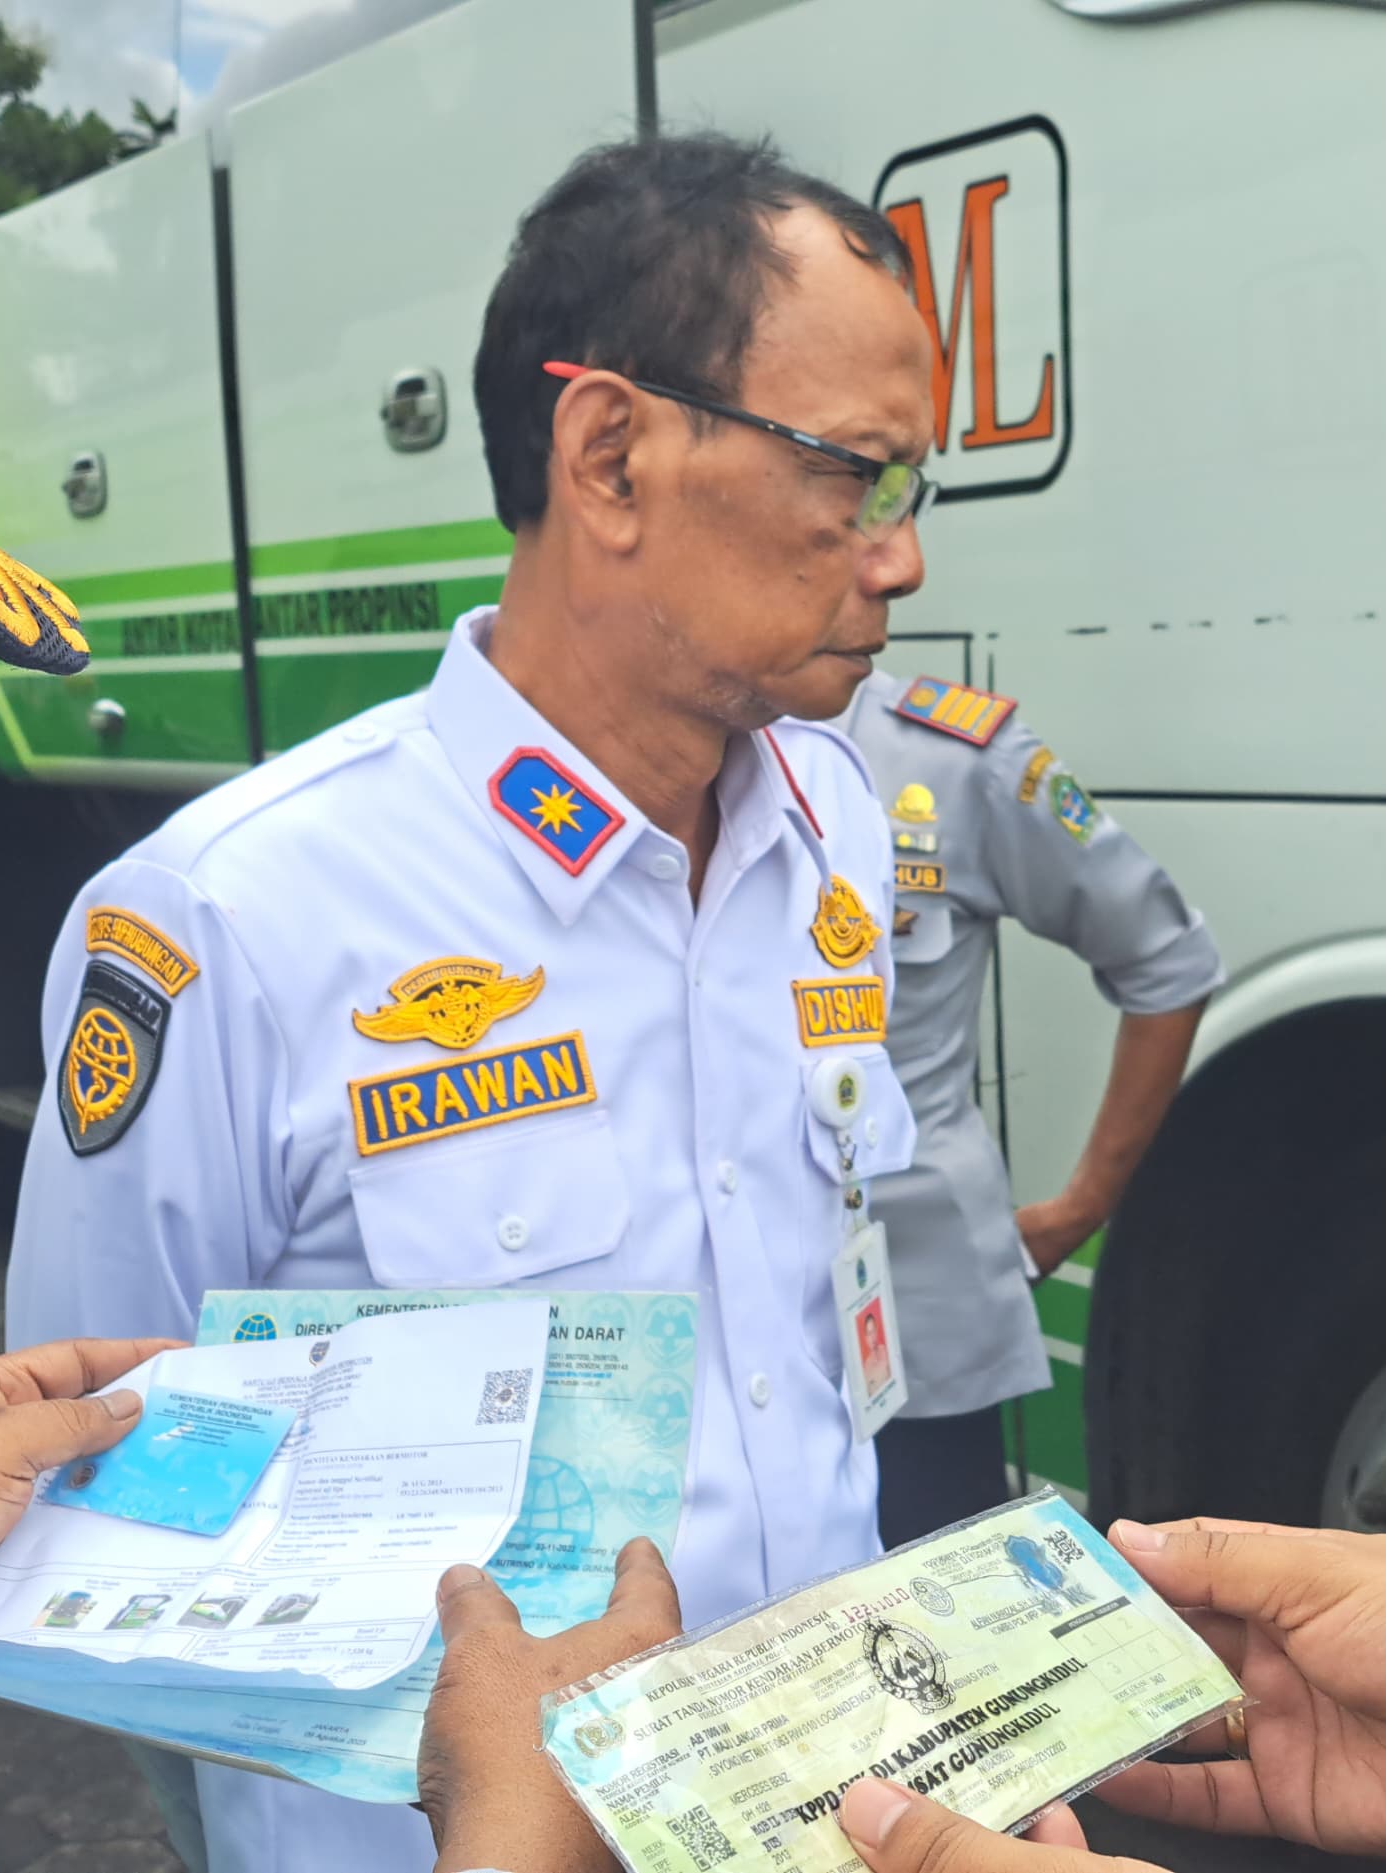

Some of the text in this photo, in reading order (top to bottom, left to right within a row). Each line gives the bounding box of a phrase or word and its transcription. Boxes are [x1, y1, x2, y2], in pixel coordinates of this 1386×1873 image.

[325, 582, 441, 636] PROPINSI
[803, 986, 883, 1035] DISHU
[370, 1045, 578, 1140] IRAWAN
[574, 1327, 626, 1342] DARAT
[699, 1659, 734, 1684] NEGARA
[734, 1637, 778, 1672] REPUBLIK
[778, 1609, 832, 1650] INDONESIA
[633, 1715, 675, 1742] SURAT
[674, 1700, 709, 1724] TANDA
[708, 1684, 748, 1711] NOMOR
[746, 1655, 813, 1696] KENDARAAN
[689, 1730, 705, 1747] AB
[762, 1713, 790, 1739] PRIMA
[797, 1789, 840, 1826] KPPD
[870, 1757, 896, 1781] DI
[893, 1704, 990, 1770] KABUPATEN
[984, 1655, 1089, 1718] GUNUNGKIDUL
[907, 1760, 953, 1798] SAT
[948, 1701, 1063, 1773] GUNUNGKIDUL
[596, 1748, 681, 1799] NOMOR REGISTRASI
[606, 1772, 672, 1812] NAMA PEMILIK
[730, 1771, 793, 1806] MERCEDES BENZ
[619, 1802, 655, 1825] ALAMAT
[761, 1833, 783, 1855] BUS
